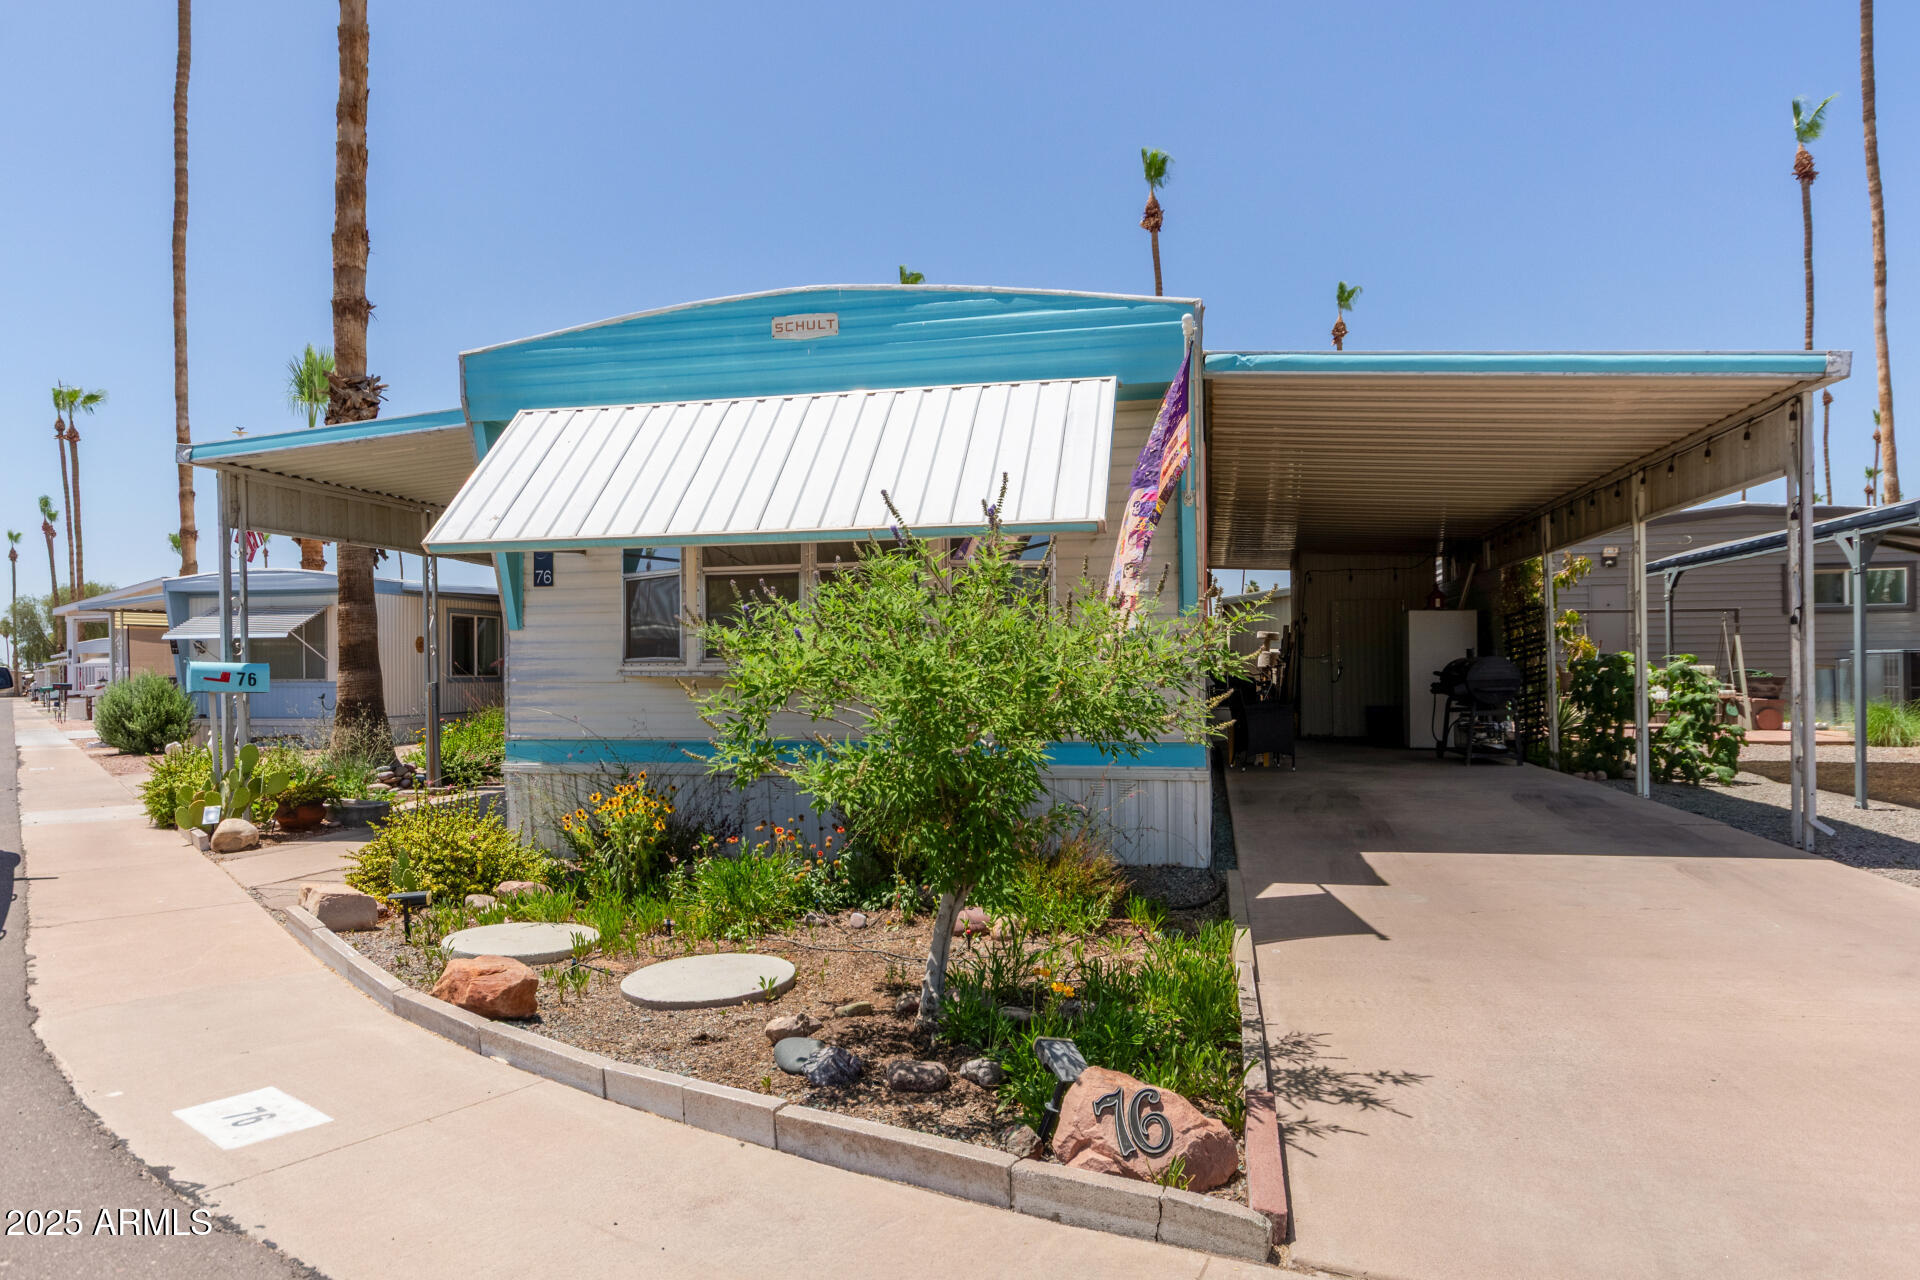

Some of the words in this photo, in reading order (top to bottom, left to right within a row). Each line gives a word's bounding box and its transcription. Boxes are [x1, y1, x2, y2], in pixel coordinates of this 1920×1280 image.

[775, 319, 835, 333] SCHULT
[535, 570, 552, 584] 76
[236, 672, 257, 687] 76
[221, 1106, 277, 1127] 76
[1093, 1087, 1173, 1156] 76
